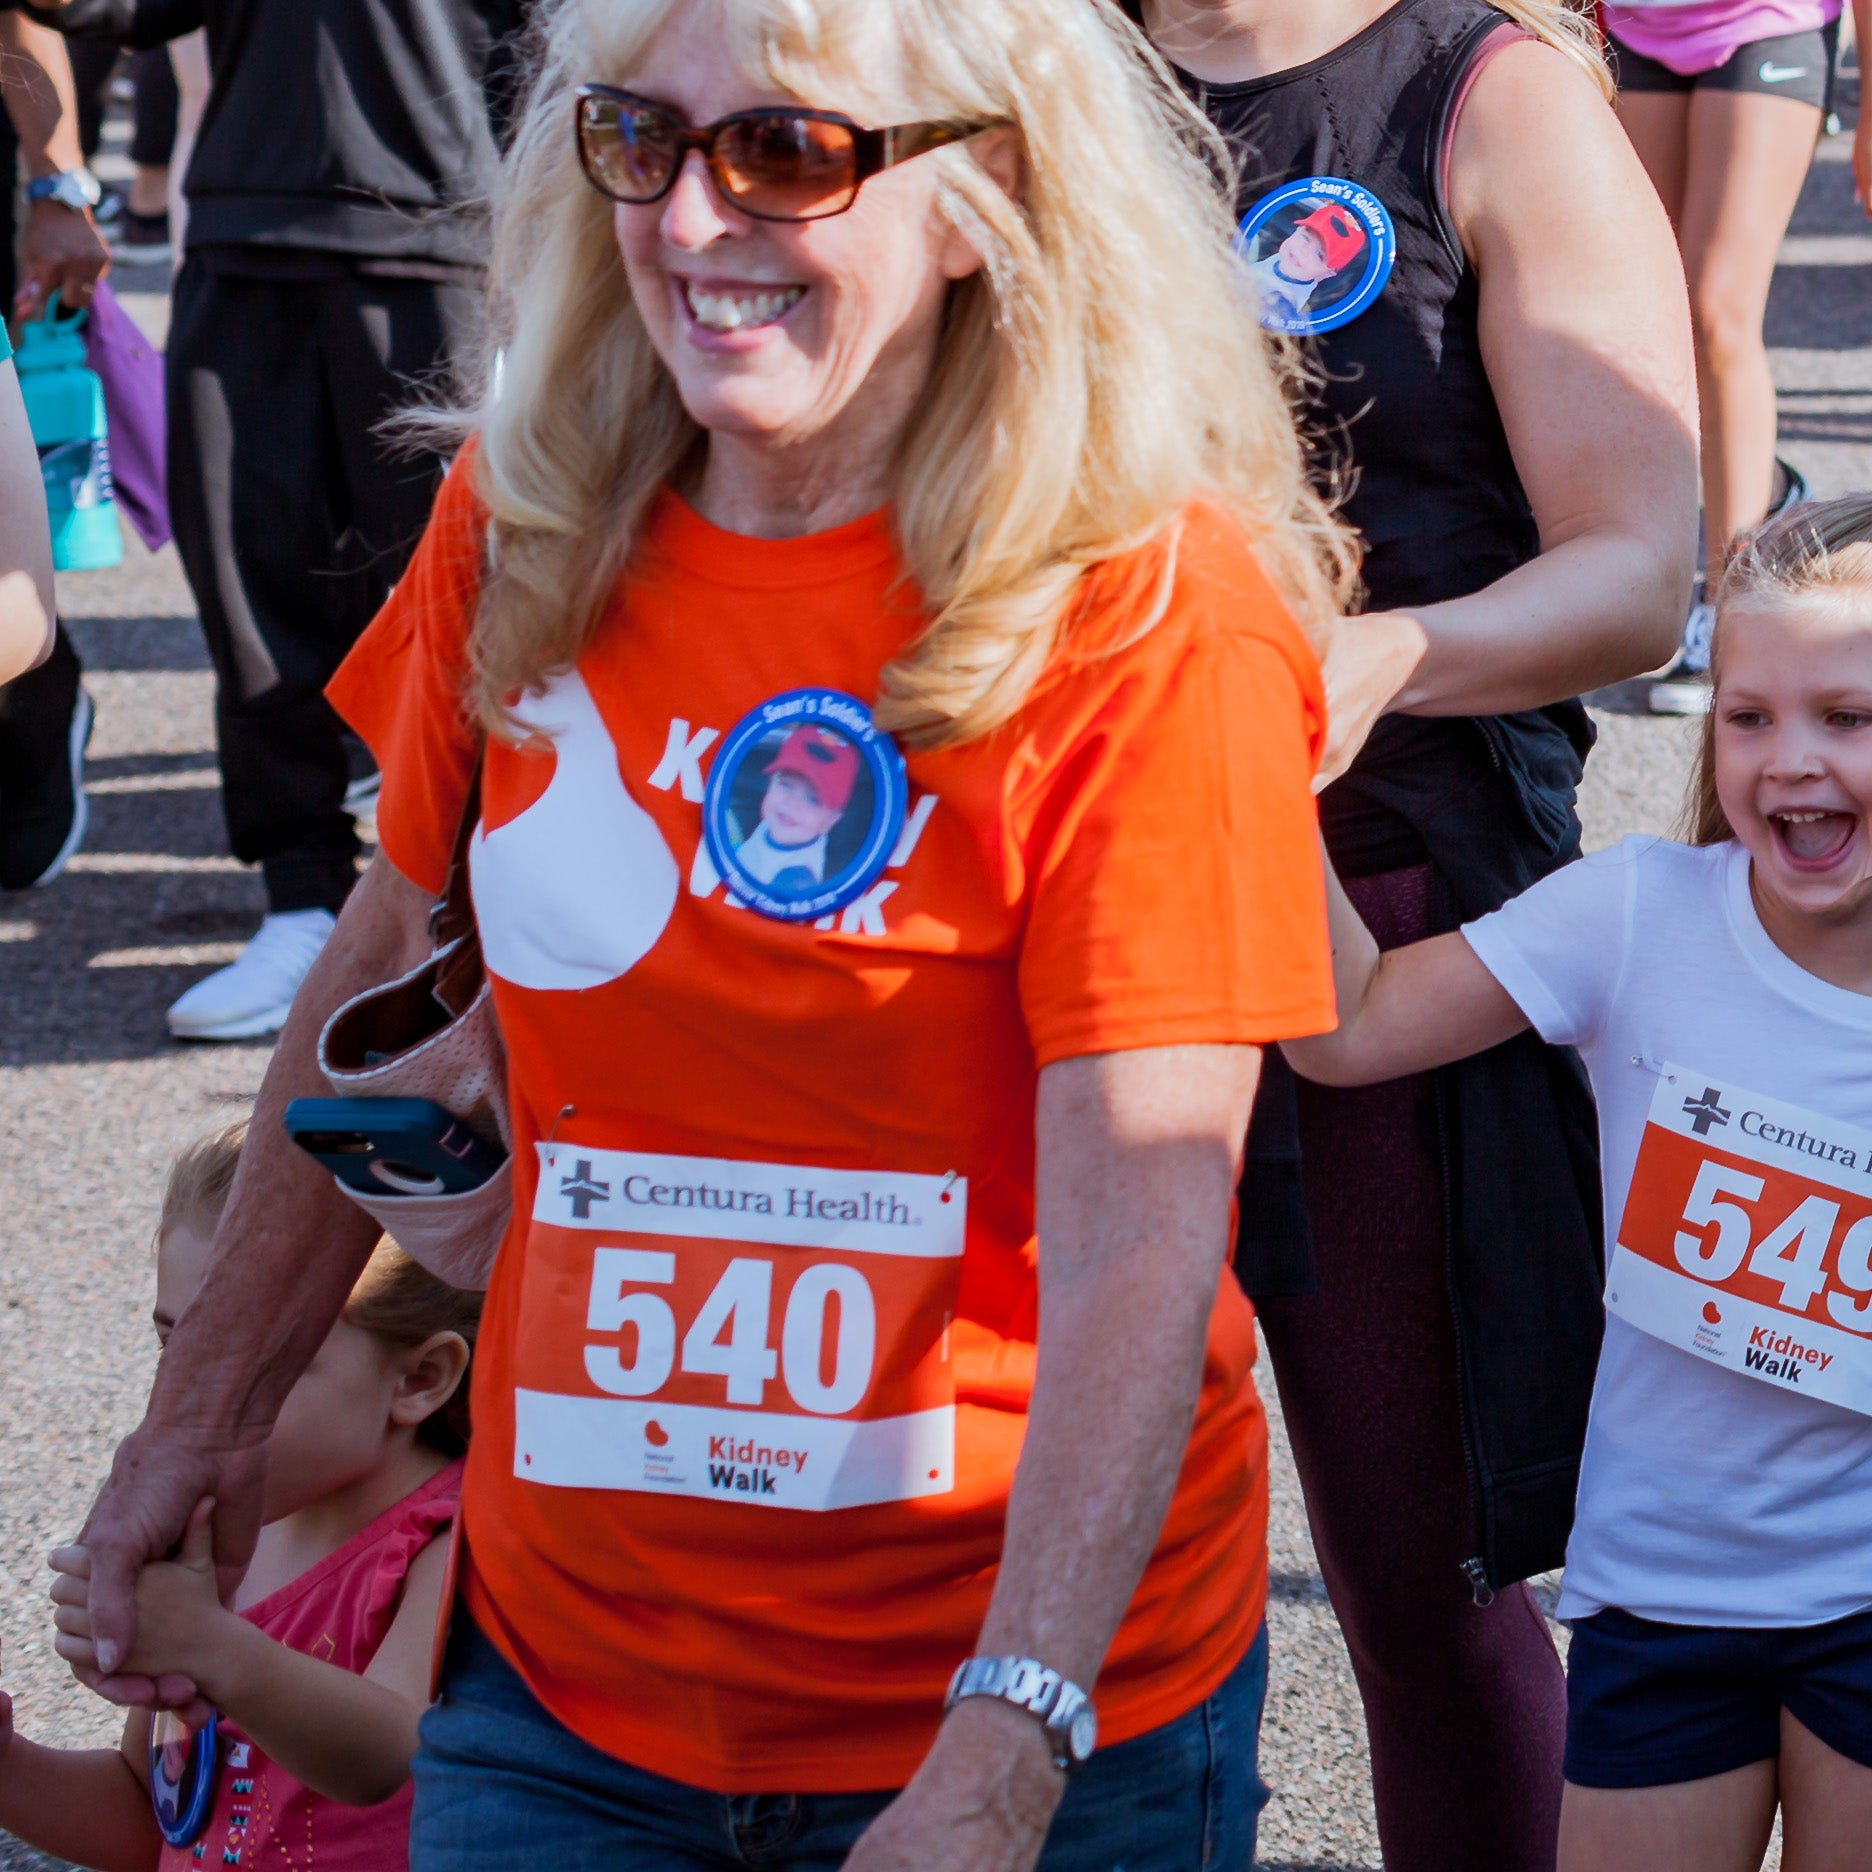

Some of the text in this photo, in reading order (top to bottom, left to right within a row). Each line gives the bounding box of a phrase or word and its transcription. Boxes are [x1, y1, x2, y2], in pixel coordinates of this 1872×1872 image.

[1310, 180, 1387, 236] Sean's Soldiers
[1739, 1111, 1858, 1169] Centura
[624, 1176, 911, 1225] Centura Health
[583, 1247, 876, 1414] 540
[1750, 1326, 1835, 1371] Kidney
[1745, 1347, 1802, 1384] Walk
[708, 1435, 809, 1474] Kidney
[708, 1463, 777, 1494] Walk
